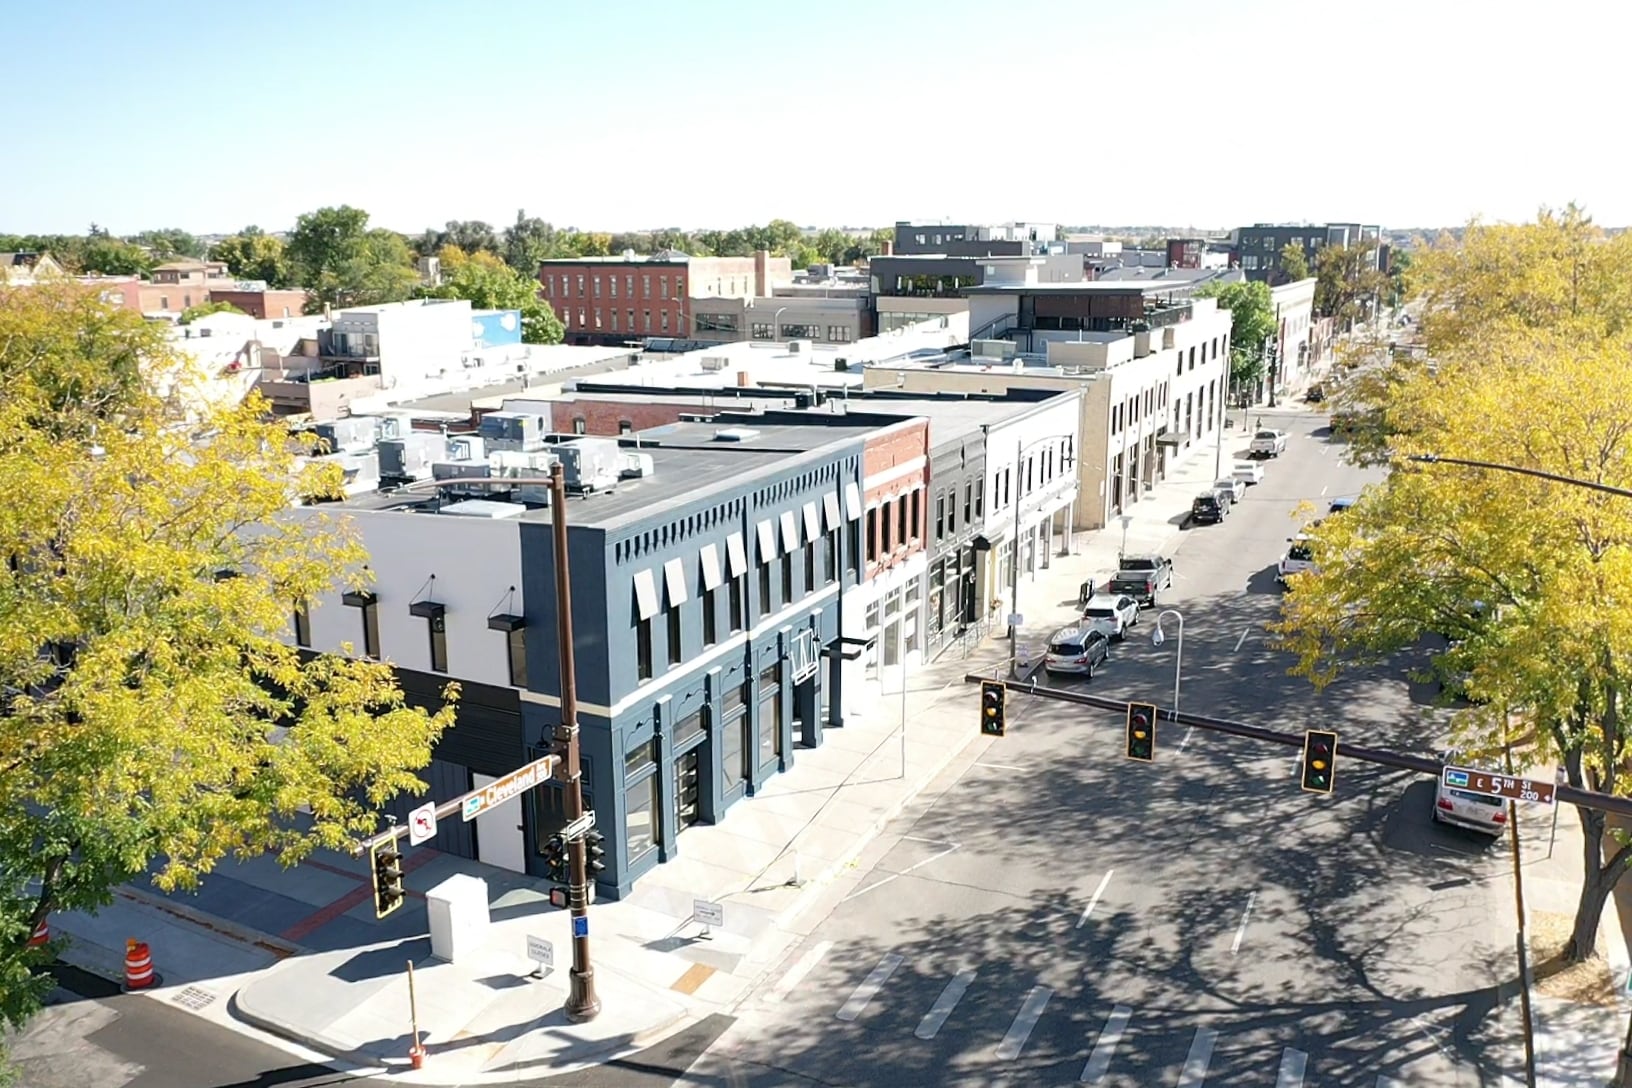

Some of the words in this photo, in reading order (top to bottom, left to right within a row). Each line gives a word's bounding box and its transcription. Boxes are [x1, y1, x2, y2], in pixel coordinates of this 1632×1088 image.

[486, 766, 535, 806] Cleveland
[1477, 778, 1483, 788] E
[1491, 777, 1514, 793] 5TH
[1520, 790, 1539, 800] 200
